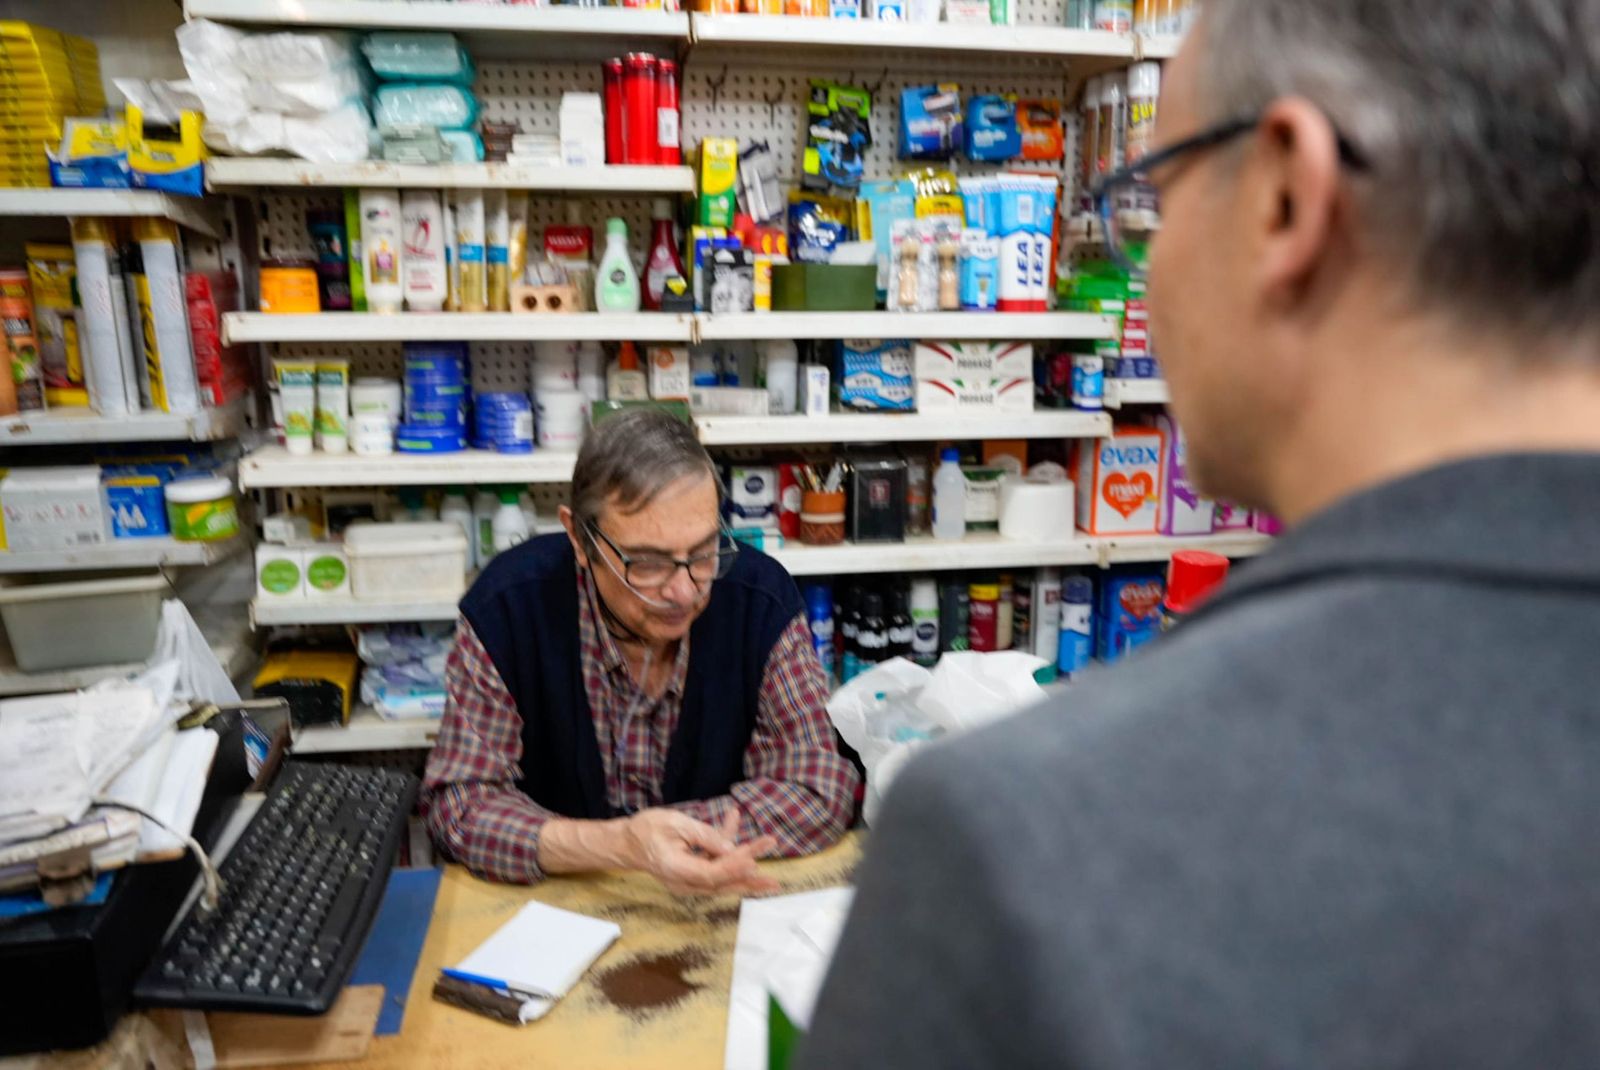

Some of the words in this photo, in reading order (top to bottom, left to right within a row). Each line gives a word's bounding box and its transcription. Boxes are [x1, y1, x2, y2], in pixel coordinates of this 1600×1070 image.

[1017, 242, 1028, 286] LEA
[1032, 242, 1043, 286] LEA
[1101, 447, 1157, 465] evax
